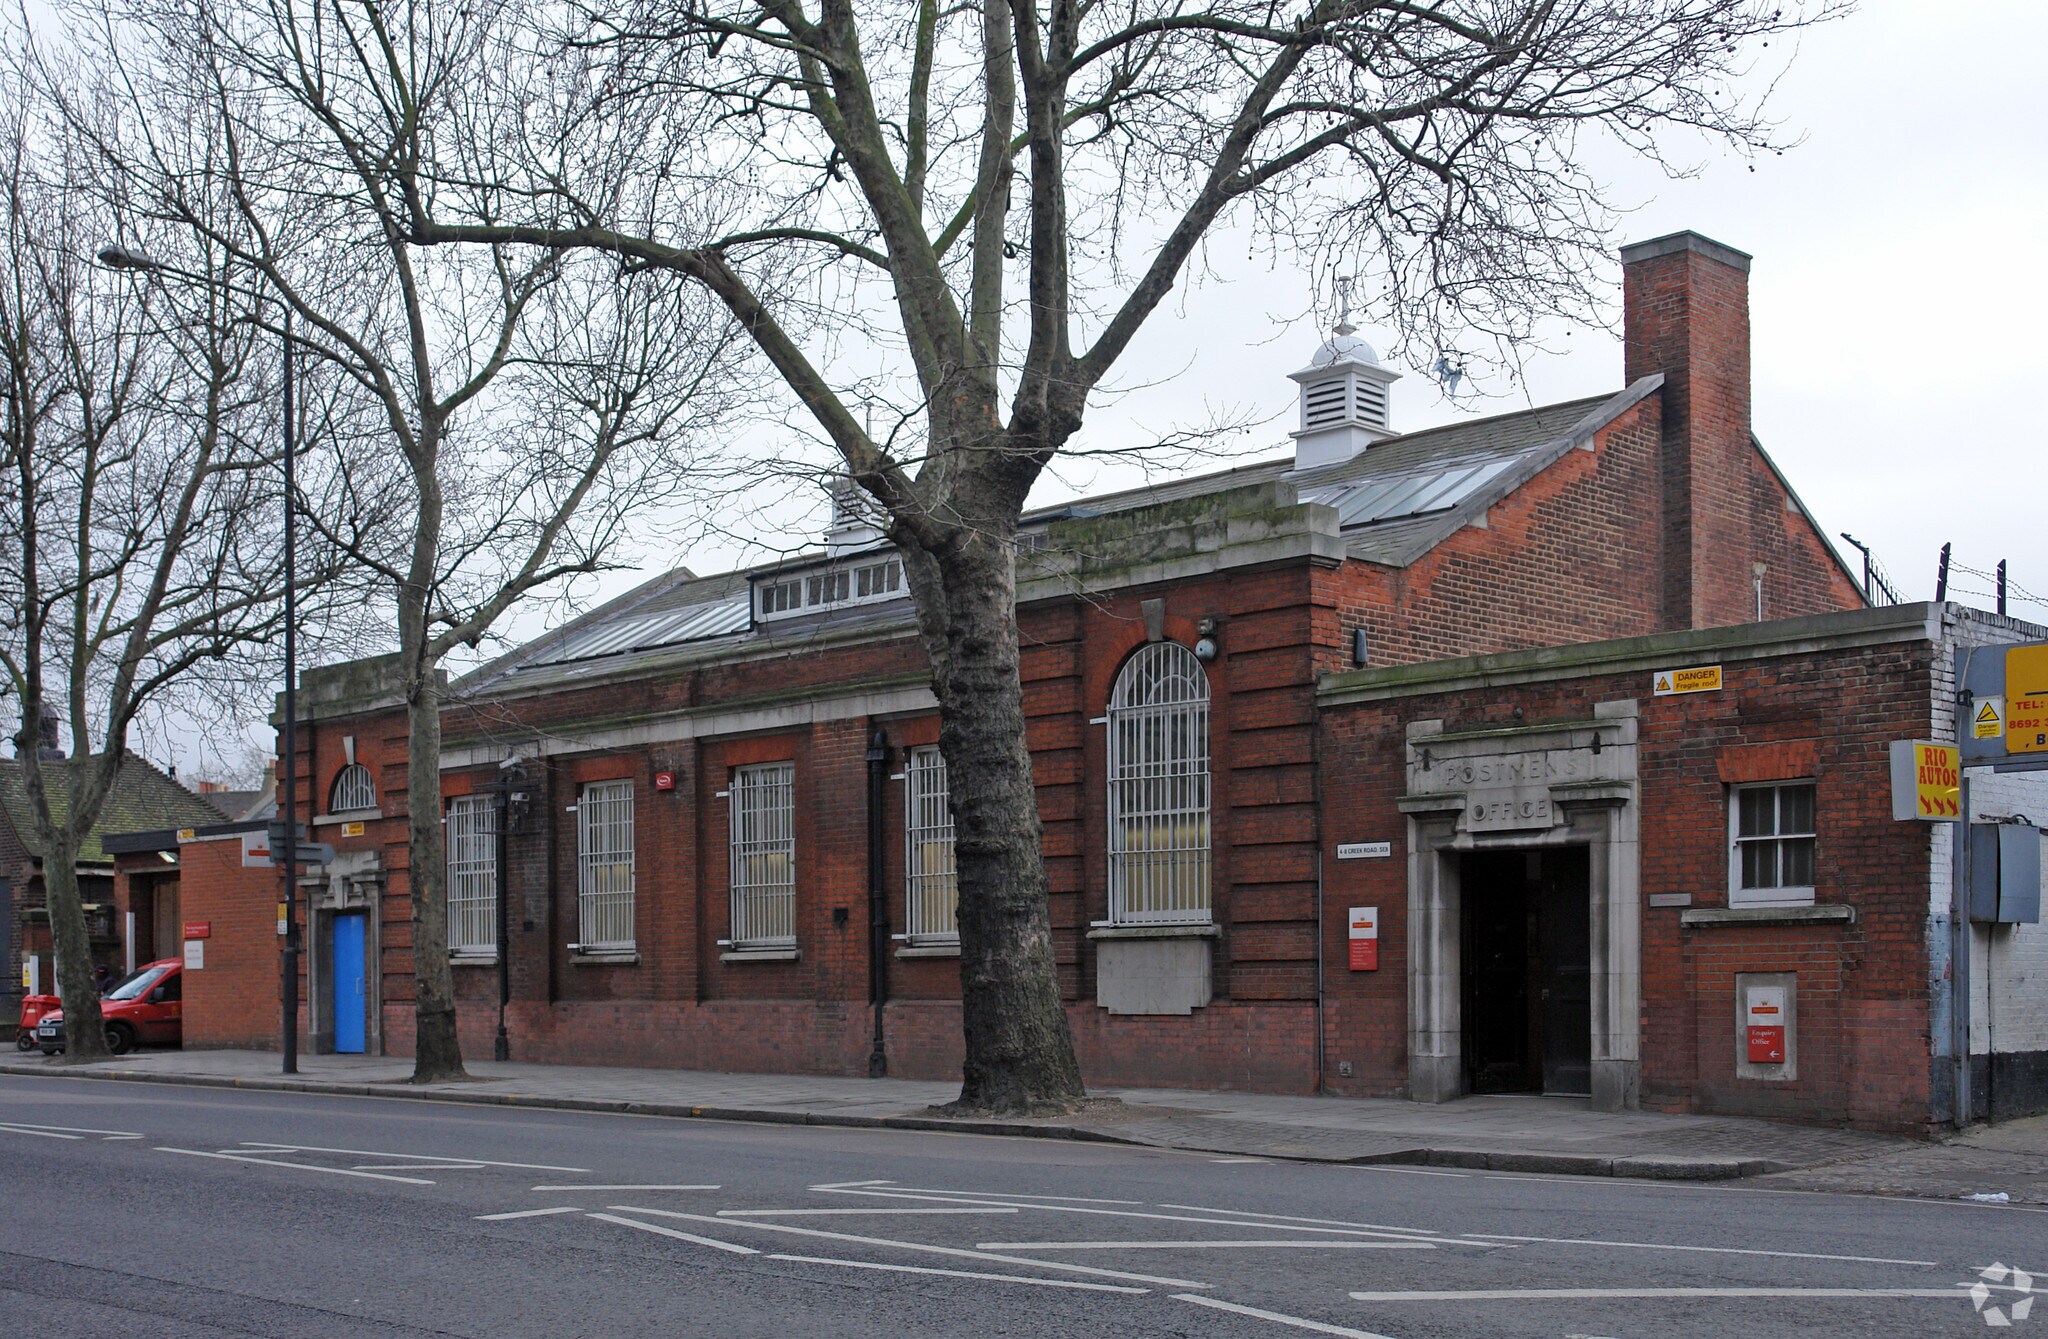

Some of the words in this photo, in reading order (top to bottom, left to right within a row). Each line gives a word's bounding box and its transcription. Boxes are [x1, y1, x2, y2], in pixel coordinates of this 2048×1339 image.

[1678, 670, 1715, 681] DANGER
[1676, 682, 1699, 690] Fragile
[1702, 678, 1718, 687] roof
[2015, 700, 2044, 710] TEL:
[2009, 718, 2040, 729] 8692
[1924, 747, 1947, 767] RIO
[1919, 766, 1957, 787] AUTOS
[1472, 800, 1547, 821] OFFICE
[1752, 1029, 1776, 1037] Enquiry
